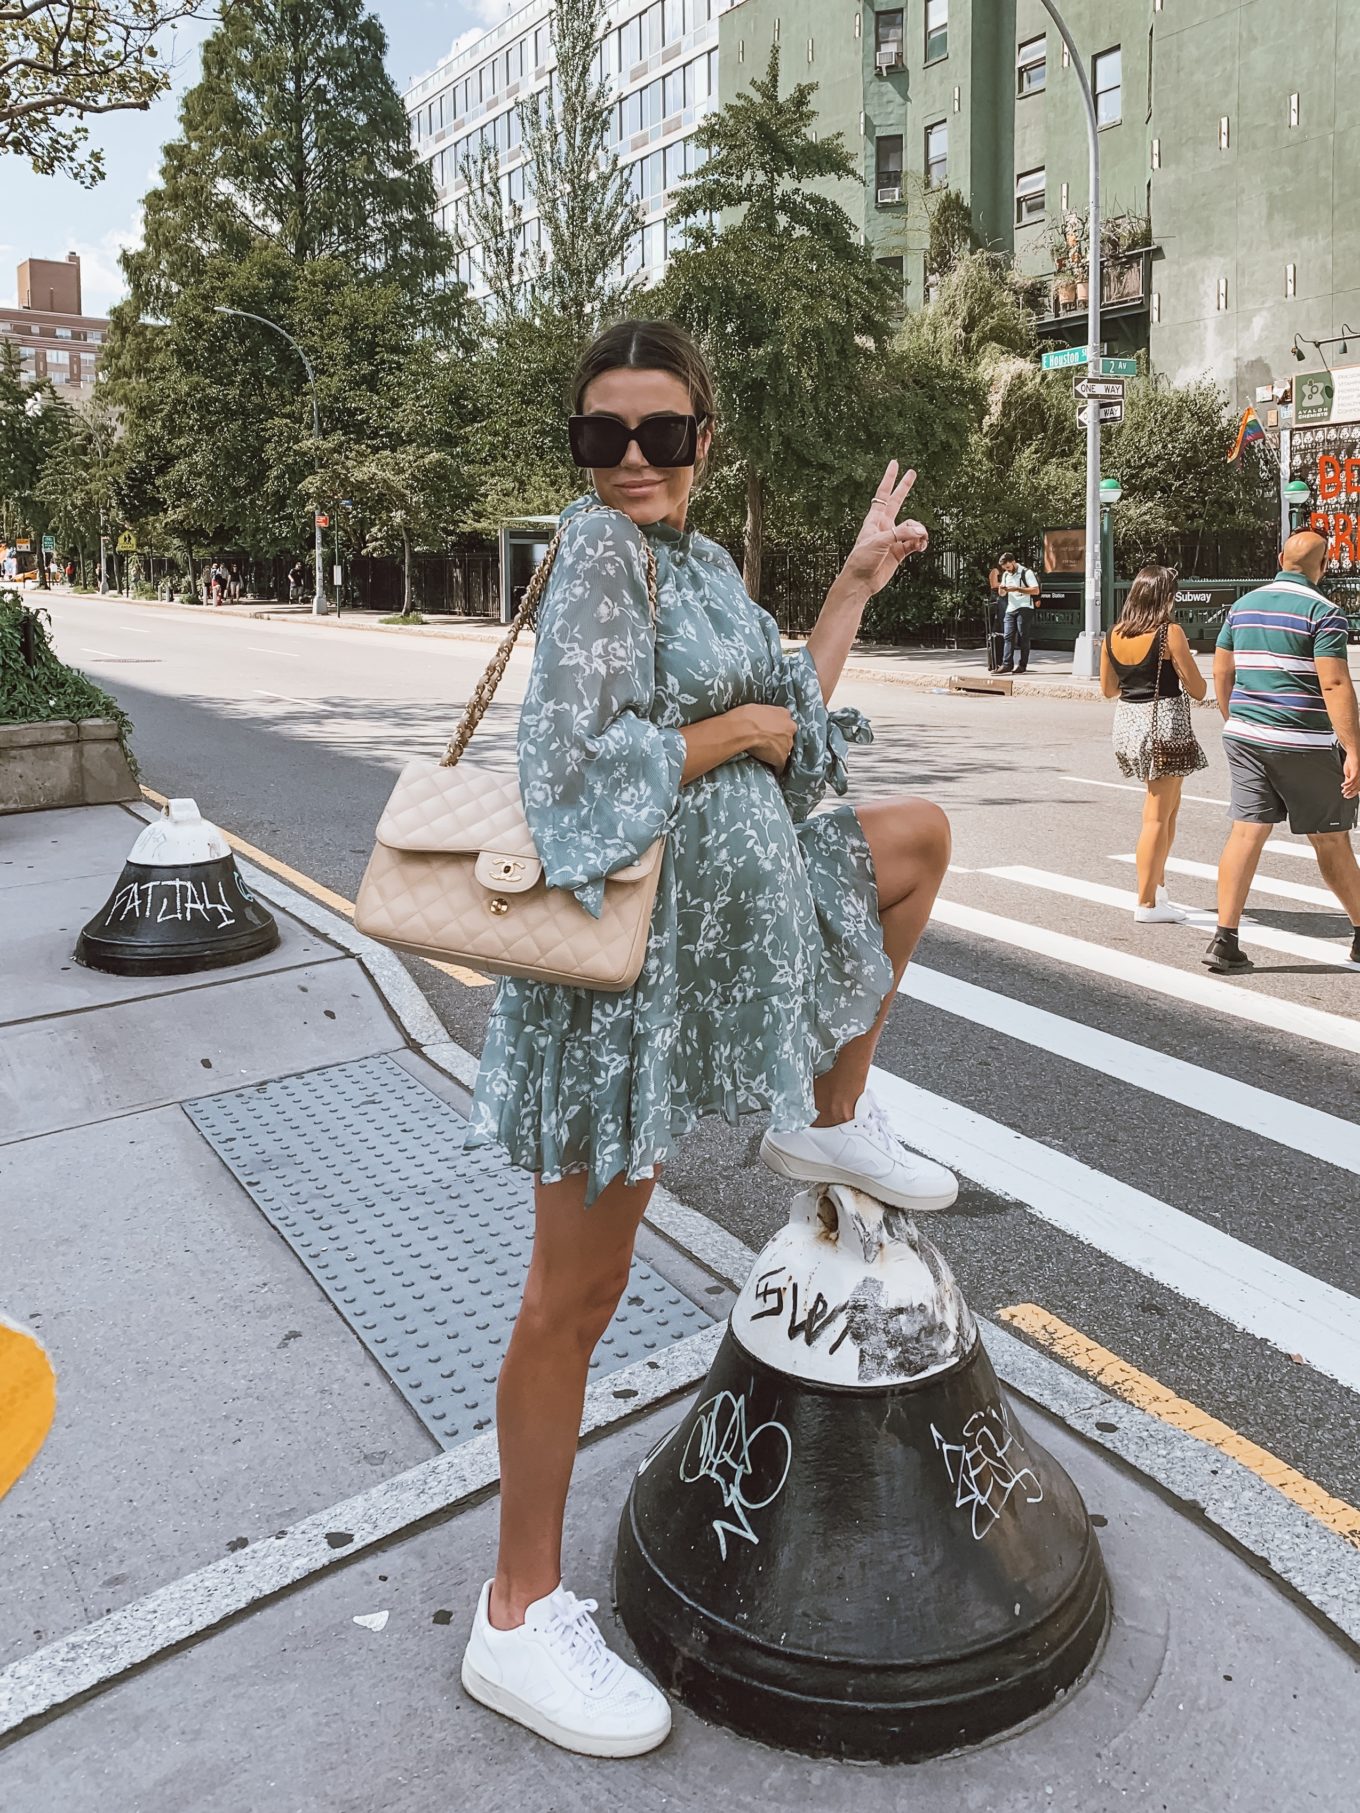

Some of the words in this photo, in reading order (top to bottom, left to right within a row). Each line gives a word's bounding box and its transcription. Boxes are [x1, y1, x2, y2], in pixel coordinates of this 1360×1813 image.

[1050, 352, 1079, 367] Houston
[1109, 361, 1115, 373] 2
[1118, 361, 1127, 369] Av
[1080, 384, 1096, 393] ONE
[1104, 385, 1121, 393] WAY
[1103, 408, 1119, 416] WAY
[1297, 407, 1329, 415] AVALON
[1175, 592, 1211, 603] Subway
